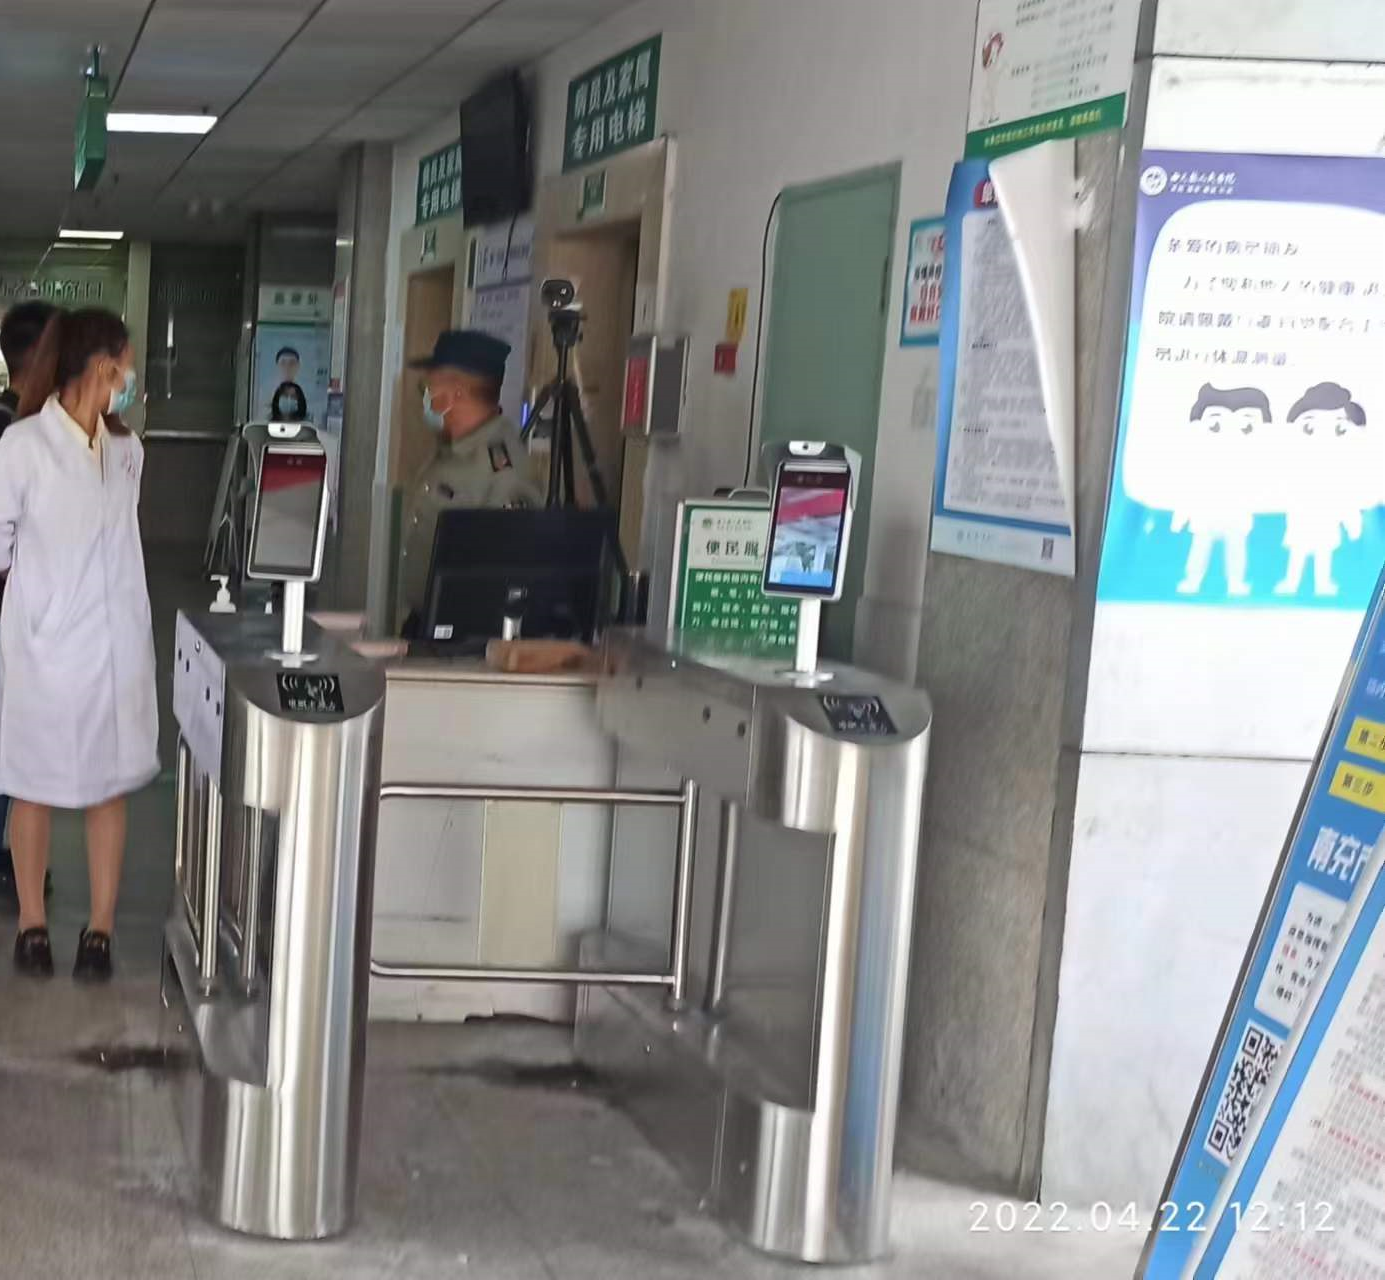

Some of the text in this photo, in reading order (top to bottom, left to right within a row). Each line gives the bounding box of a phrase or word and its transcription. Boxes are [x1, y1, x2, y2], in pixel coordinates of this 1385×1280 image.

[571, 96, 647, 160] 专用电梯
[706, 540, 764, 559] 便民服
